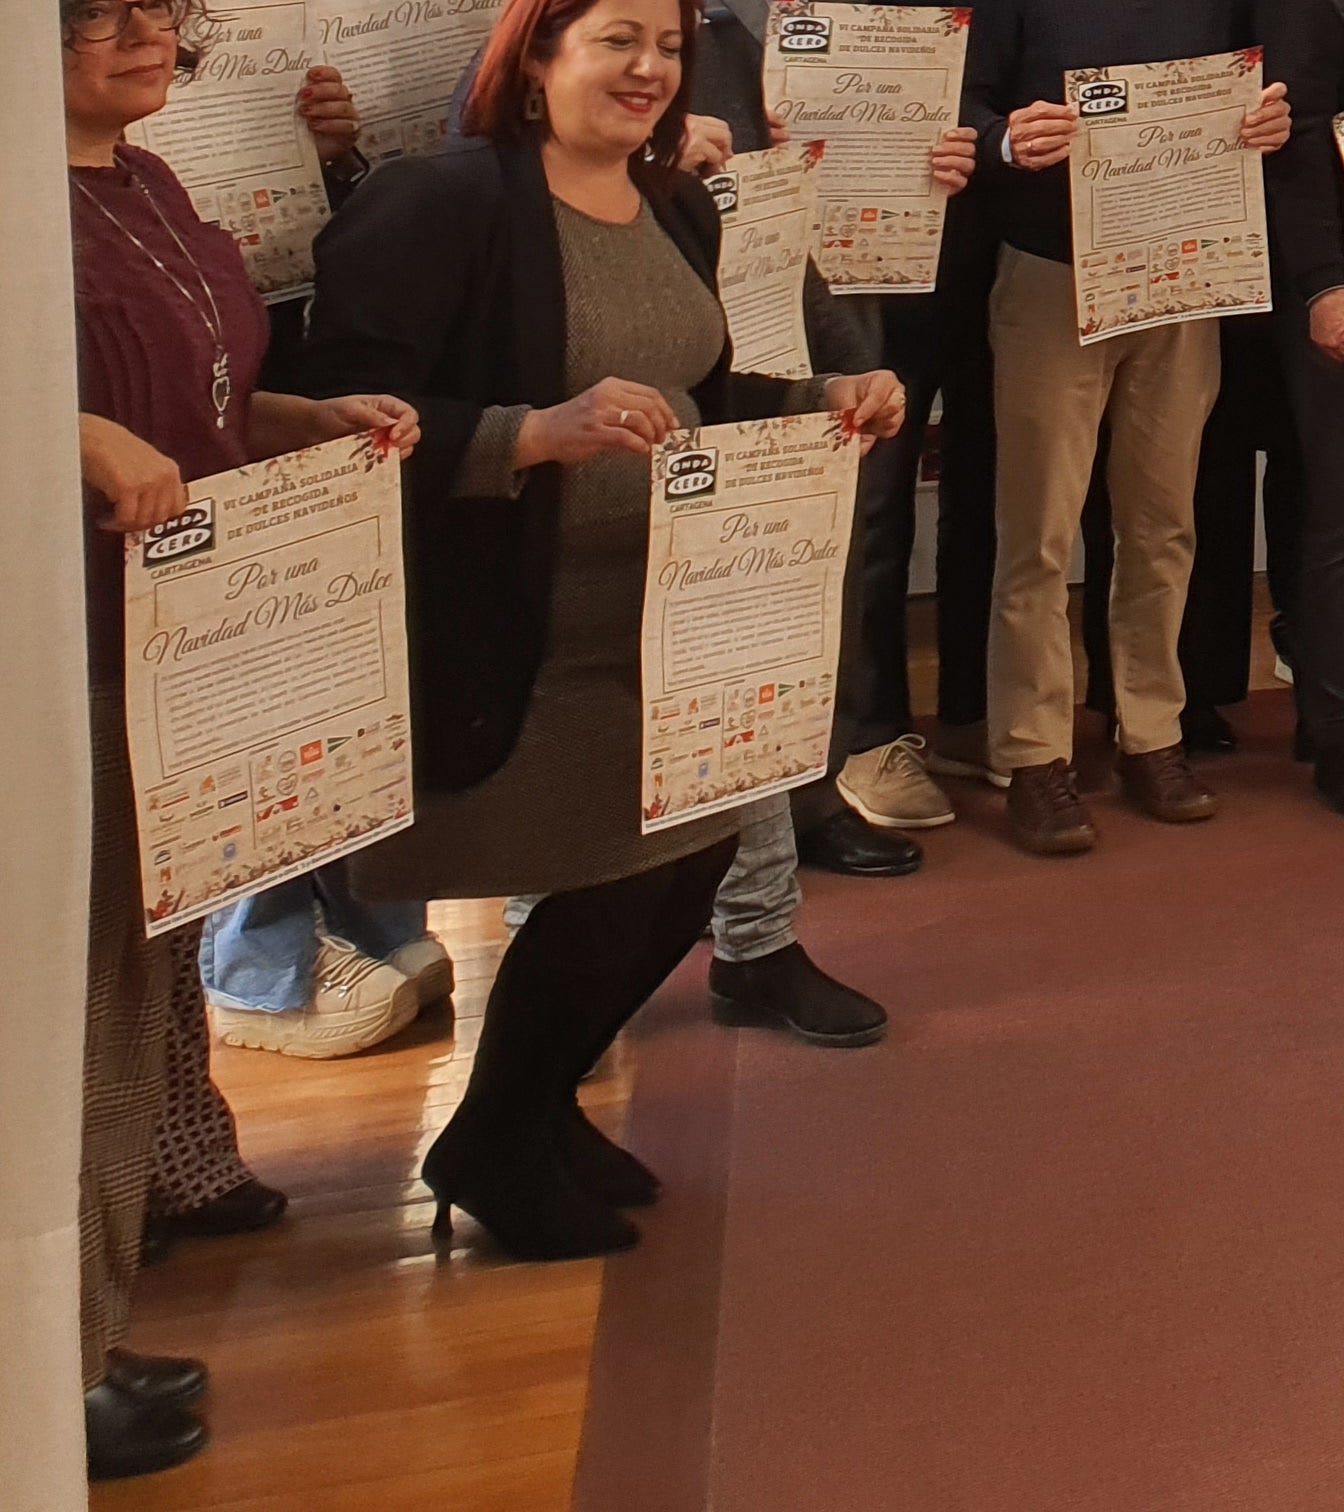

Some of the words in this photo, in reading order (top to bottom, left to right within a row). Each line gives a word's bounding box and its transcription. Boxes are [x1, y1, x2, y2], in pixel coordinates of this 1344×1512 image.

[320, 10, 393, 44] Navidad
[833, 73, 870, 94] Por
[1138, 126, 1173, 148] Por
[1082, 156, 1156, 181] Navidad
[223, 499, 237, 511] VI
[300, 462, 359, 487] SOLIDARIA
[253, 504, 269, 516] DE
[272, 487, 330, 511] RECOGIDA
[154, 513, 203, 534] ONDA
[227, 527, 243, 539] DE
[246, 513, 290, 534] DULCES
[293, 492, 359, 520] NAVIDEÑOS
[156, 532, 203, 553] CERO
[151, 556, 212, 580] CARTAGENA
[225, 562, 278, 600] Por
[284, 557, 319, 581] una
[143, 610, 252, 665] Navidad
[254, 592, 318, 629] Más
[325, 568, 393, 608] Dulce
